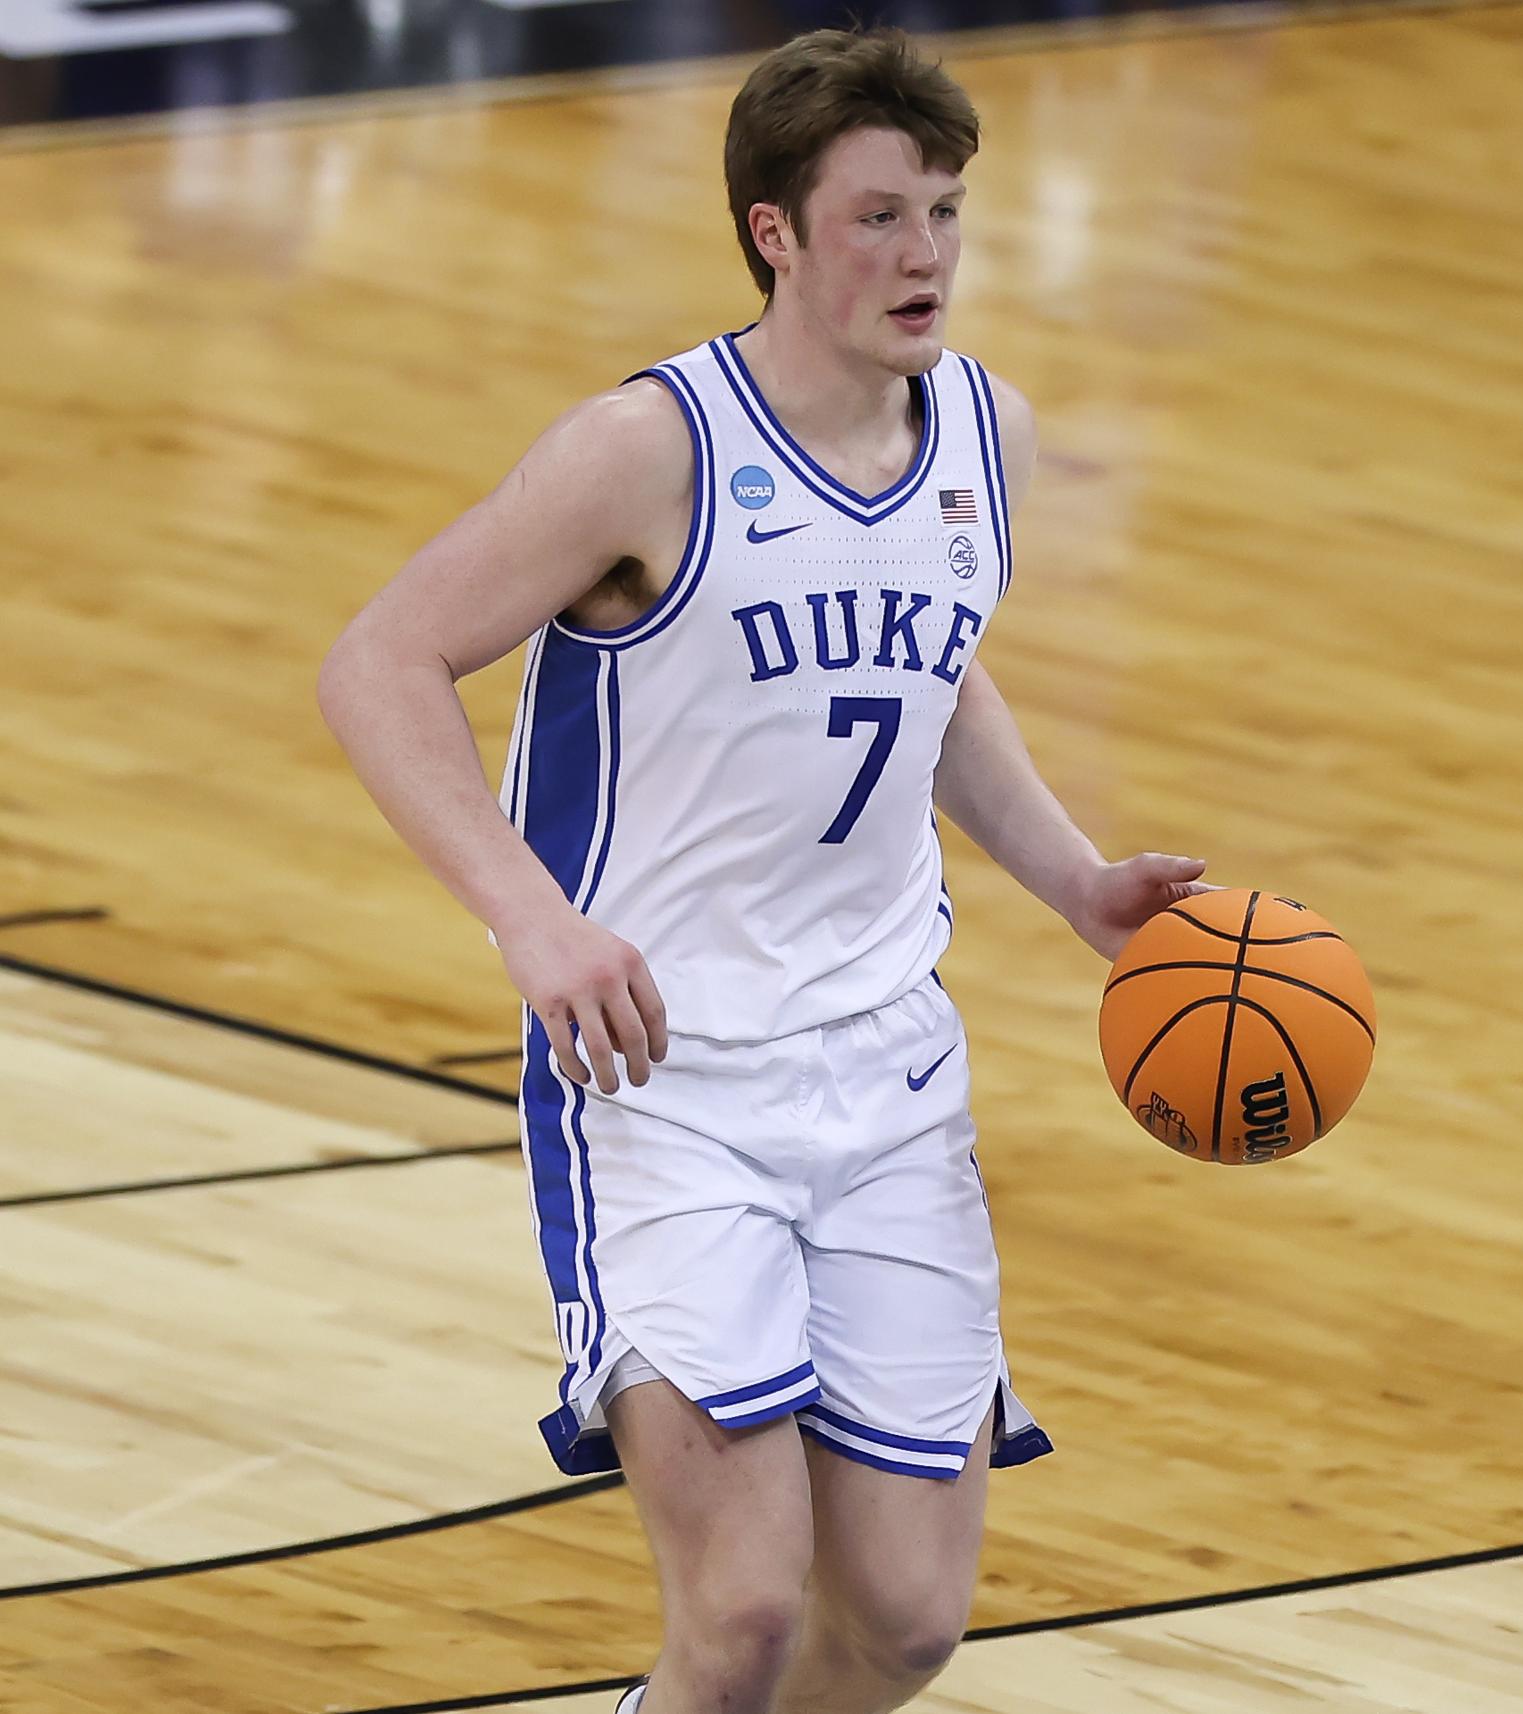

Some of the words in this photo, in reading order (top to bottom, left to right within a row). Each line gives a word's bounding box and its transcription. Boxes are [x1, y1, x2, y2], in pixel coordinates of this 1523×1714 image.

[737, 485, 772, 498] NCAA
[953, 550, 976, 560] ACC
[731, 588, 982, 686] DUKE
[818, 697, 902, 844] 7
